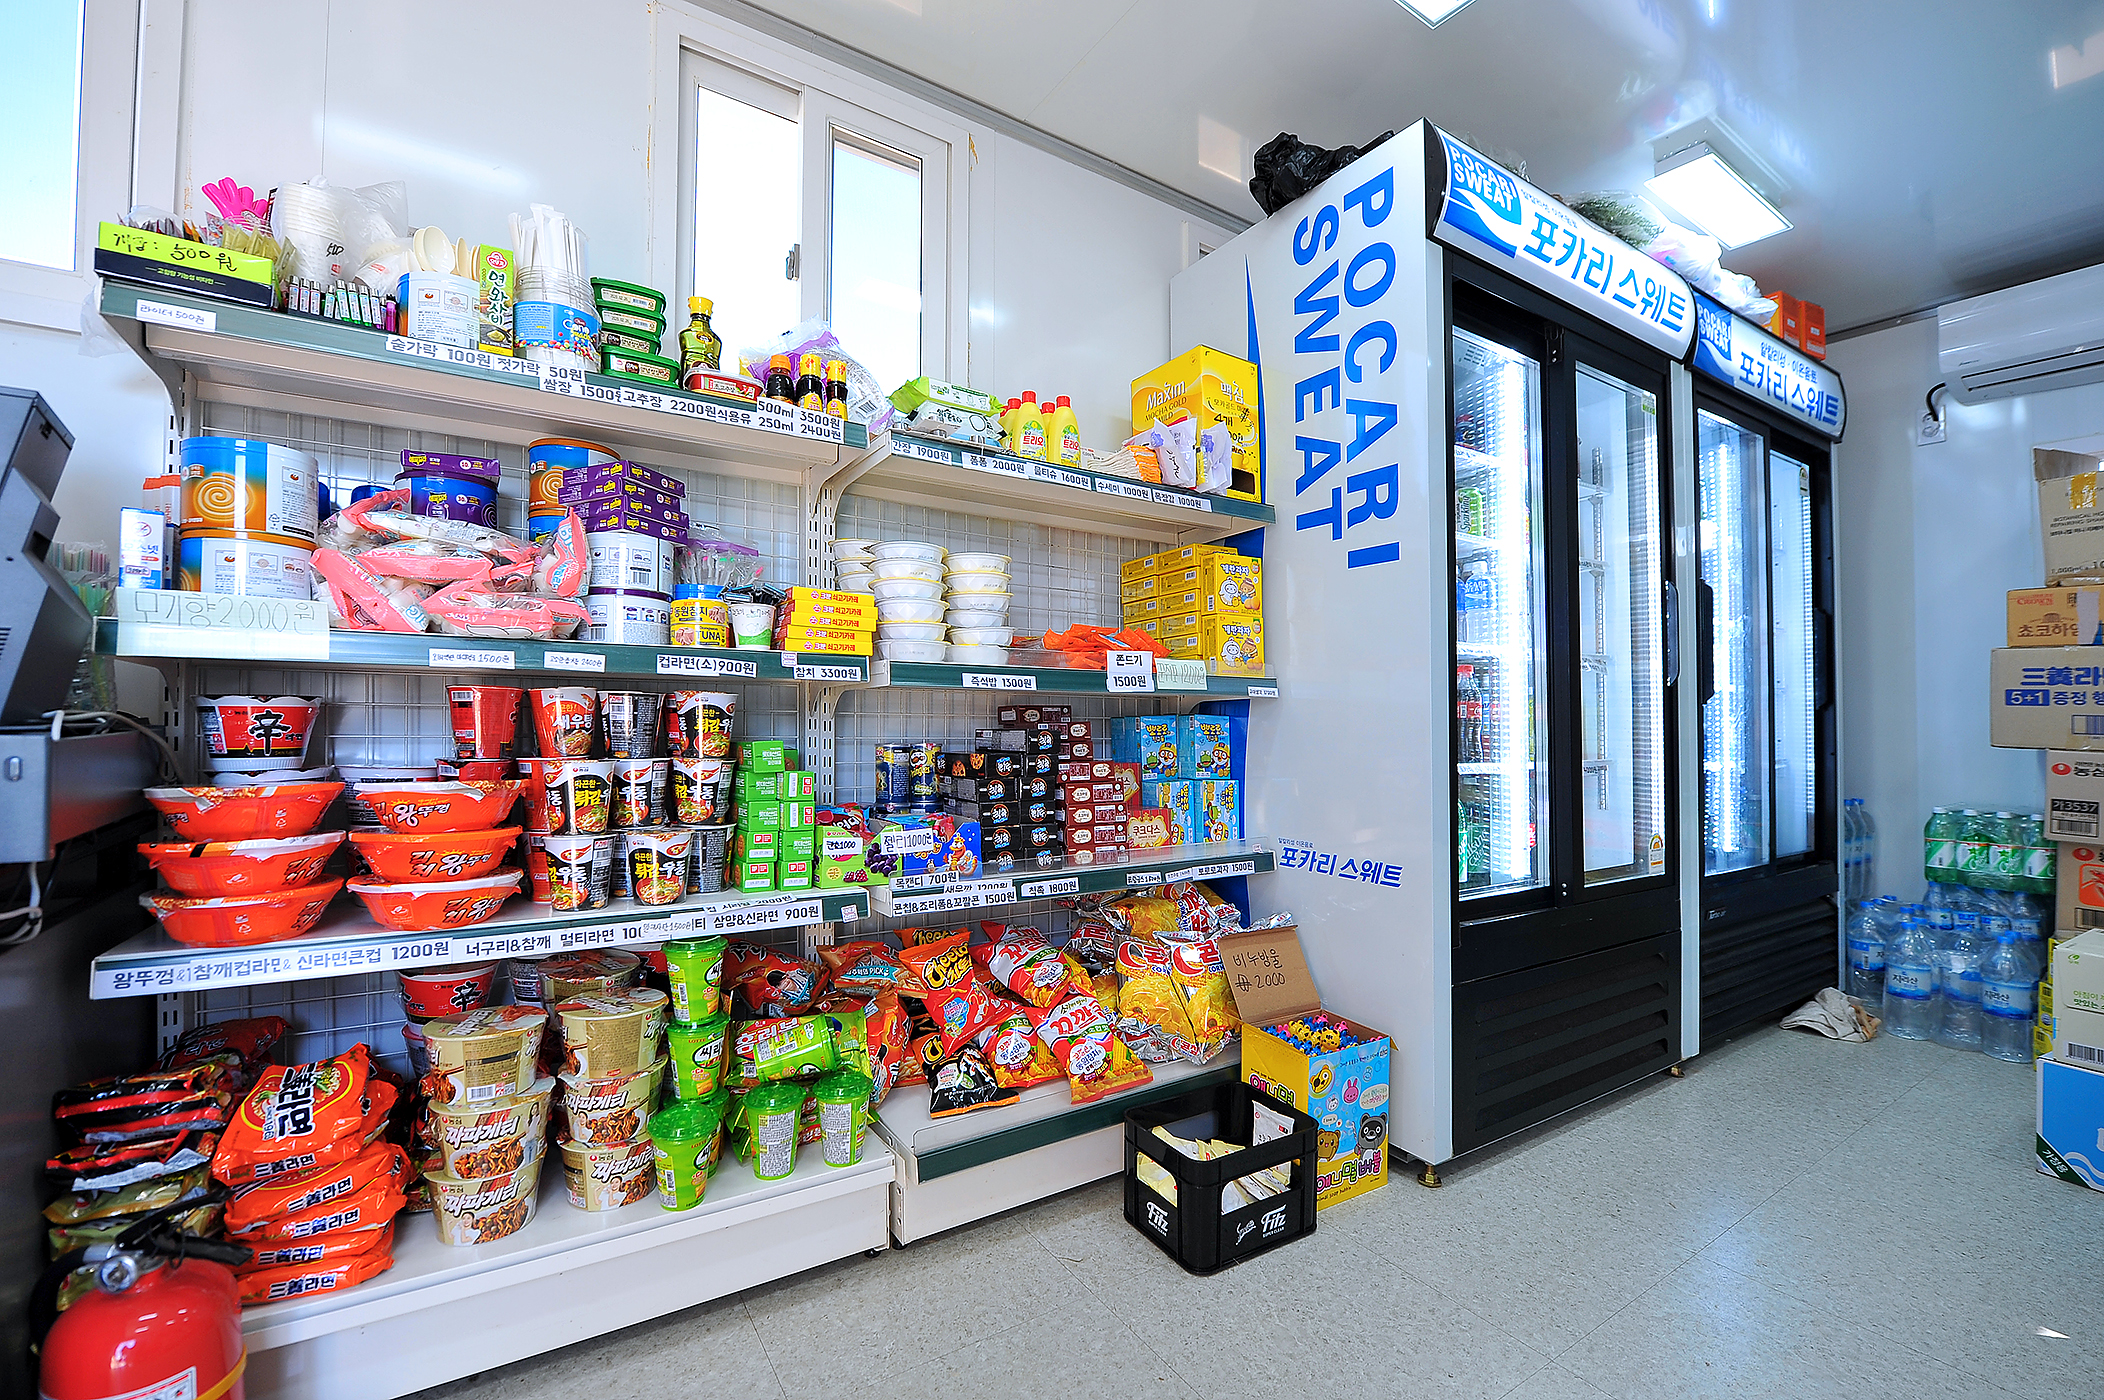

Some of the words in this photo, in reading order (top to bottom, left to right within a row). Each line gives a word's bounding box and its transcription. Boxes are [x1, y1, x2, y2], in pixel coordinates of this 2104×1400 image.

[1449, 144, 1517, 198] POCARI
[1455, 163, 1512, 211] SWEAT
[1697, 303, 1731, 339] POCARI
[1700, 318, 1731, 352] SWEAT
[447, 348, 491, 368] 100원
[1343, 166, 1401, 570] POCARI
[498, 359, 540, 375] 젓가락
[550, 366, 582, 382] 50원
[1292, 204, 1344, 543] SWEAT
[1146, 381, 1187, 411] Maxim
[1220, 381, 1244, 404] 맥심
[623, 391, 662, 408] 고추장
[670, 400, 716, 417] 2200원
[1169, 397, 1187, 411] GOLD
[717, 409, 751, 425] 식용유
[758, 401, 794, 418] 500ml
[800, 411, 841, 428] 3500원
[758, 417, 794, 432] 250ml
[800, 424, 841, 439] 2400원
[1023, 437, 1043, 446] 트리오
[1063, 439, 1080, 450] 트리오
[916, 446, 949, 461] 1900원
[992, 460, 1025, 473] 2000원
[1061, 473, 1089, 486] 1600원
[1123, 486, 1150, 499] 1000원
[1177, 497, 1202, 508] 1000원
[695, 631, 721, 641] TUNA
[795, 668, 815, 679] 참치
[820, 668, 858, 679] 3300원
[1002, 677, 1032, 688] 1300원
[1113, 675, 1146, 687] 1500원
[2011, 691, 2044, 705] 5+1
[249, 709, 292, 756] 辛
[1133, 825, 1161, 834] 쿠크다스
[1232, 862, 1253, 872] 1500원
[929, 872, 957, 885] 700원
[1049, 881, 1077, 893] 1800원
[985, 891, 1015, 904] 1500원
[713, 911, 779, 929] 삼양&신라면
[785, 906, 819, 920] 900원
[466, 936, 551, 957] 너구리&참깨
[560, 929, 614, 947] 멀티라면
[113, 969, 174, 989] 왕뚜껑
[391, 940, 449, 960] 1200원
[445, 1116, 520, 1148] 짜파게티
[444, 1182, 520, 1216] 짜파게티
[1146, 1202, 1168, 1232] Fitz
[1261, 1204, 1286, 1232] Fitz
